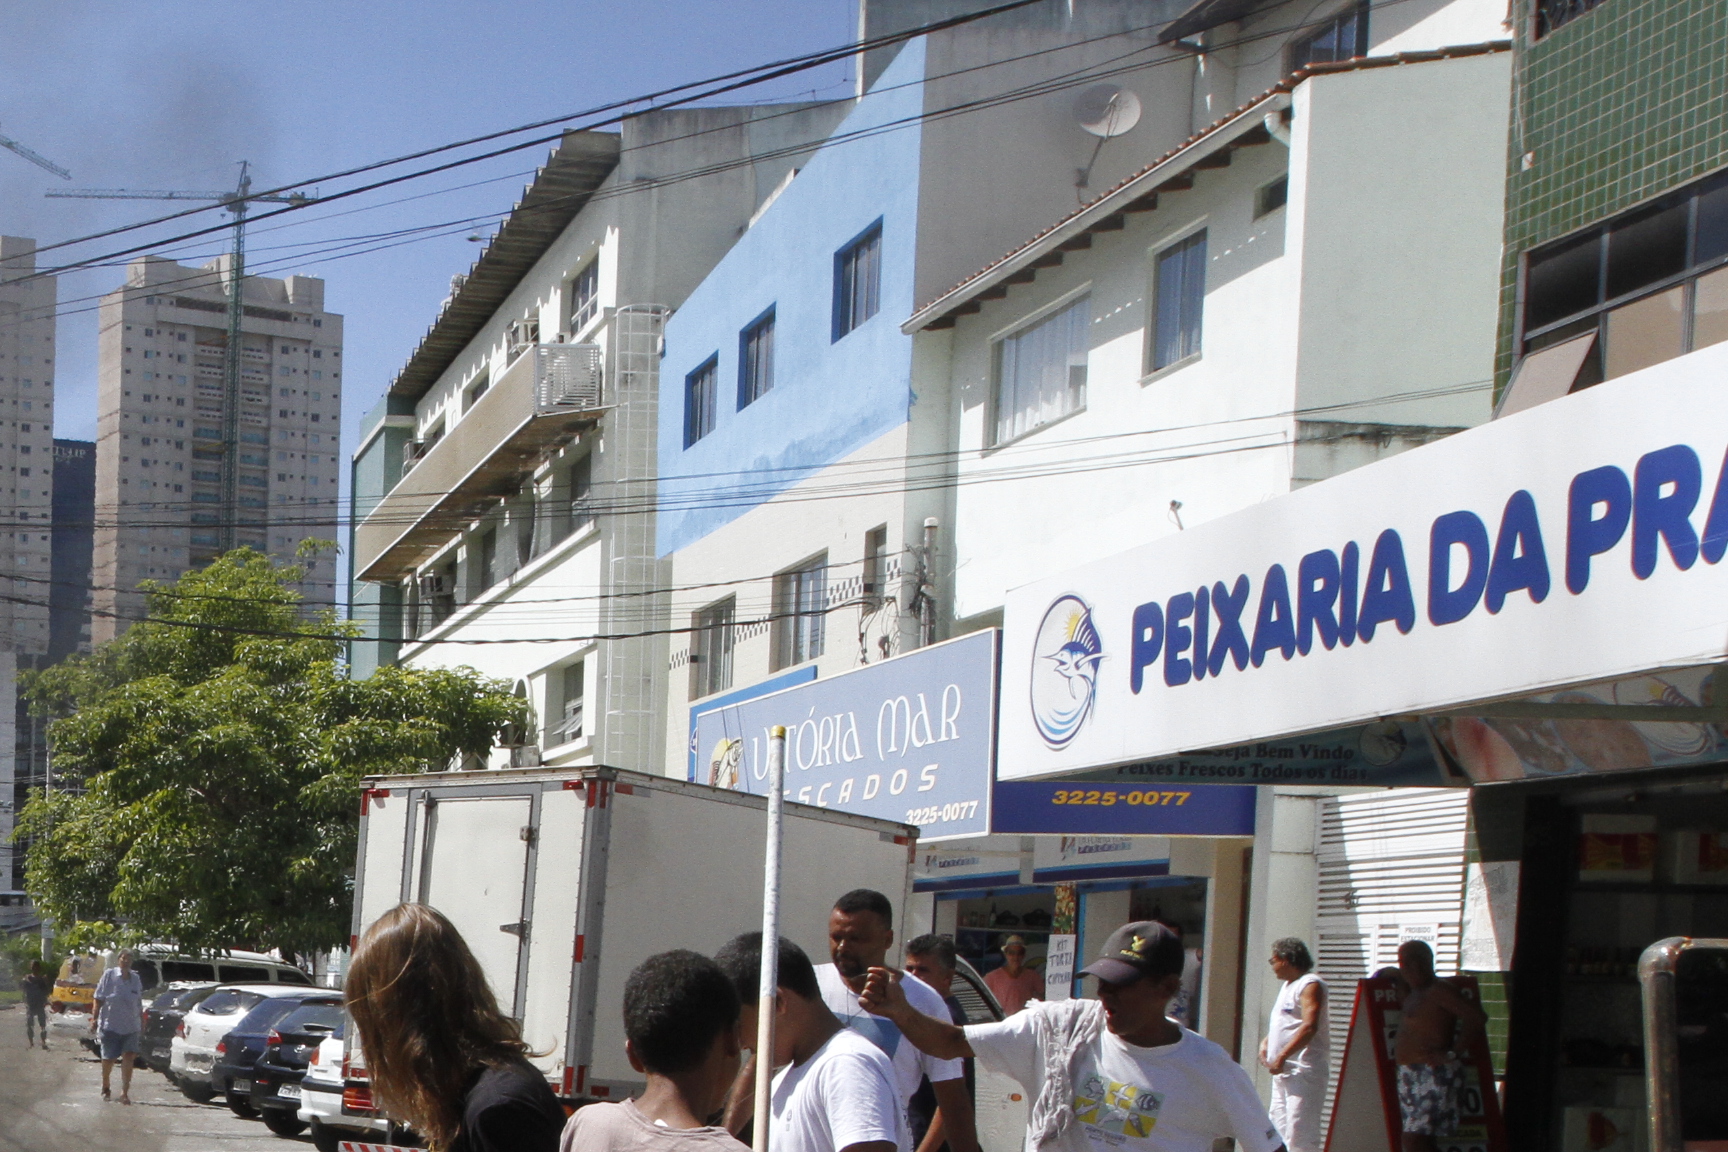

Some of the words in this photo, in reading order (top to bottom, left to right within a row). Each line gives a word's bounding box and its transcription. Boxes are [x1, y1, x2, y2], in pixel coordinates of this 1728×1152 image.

[1130, 528, 1416, 695] PEIXARIA
[1427, 489, 1551, 627] DA
[752, 705, 864, 781] VTÓRIA
[876, 684, 962, 762] MAR
[1255, 743, 1294, 758] Bem
[1299, 744, 1354, 760] Vindo
[1178, 761, 1246, 777] Frescos
[1250, 762, 1302, 778] Todos
[1331, 764, 1367, 780] dias
[1051, 790, 1191, 806] 3225-0077
[905, 800, 979, 826] 3225-0077
